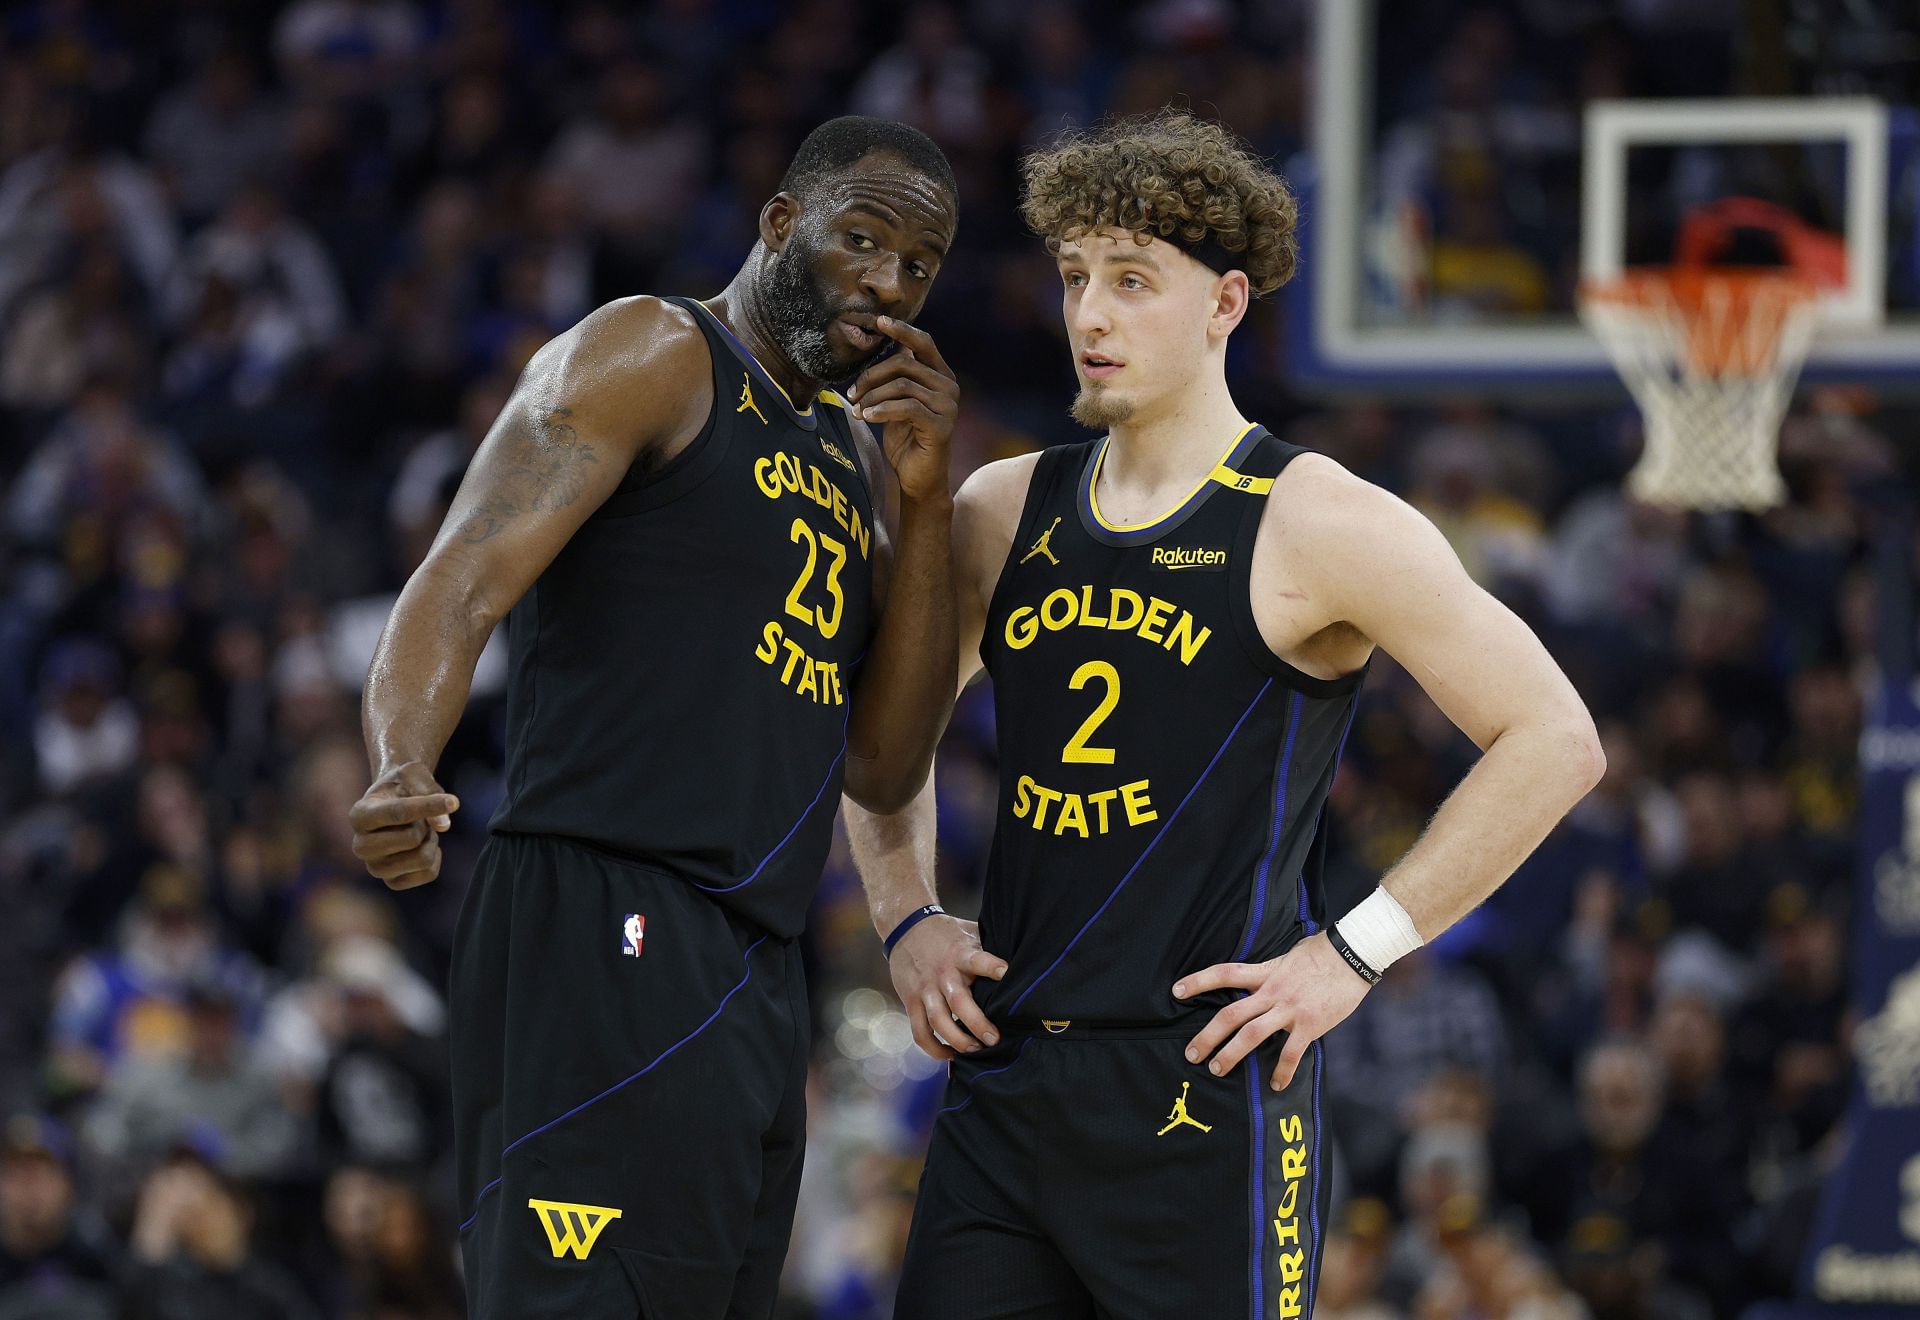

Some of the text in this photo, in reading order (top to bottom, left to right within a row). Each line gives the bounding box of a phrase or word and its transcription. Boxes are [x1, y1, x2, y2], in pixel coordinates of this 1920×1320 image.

[754, 451, 871, 562] GOLDEN
[1234, 477, 1253, 489] 16
[785, 518, 847, 639] 23
[1151, 547, 1226, 567] Rakuten
[755, 621, 844, 706] STATE
[1004, 585, 1213, 666] GOLDEN
[1061, 660, 1121, 765] 2
[1013, 775, 1158, 839] STATE
[1344, 950, 1362, 969] trust
[1274, 1114, 1307, 1320] RRIORS
